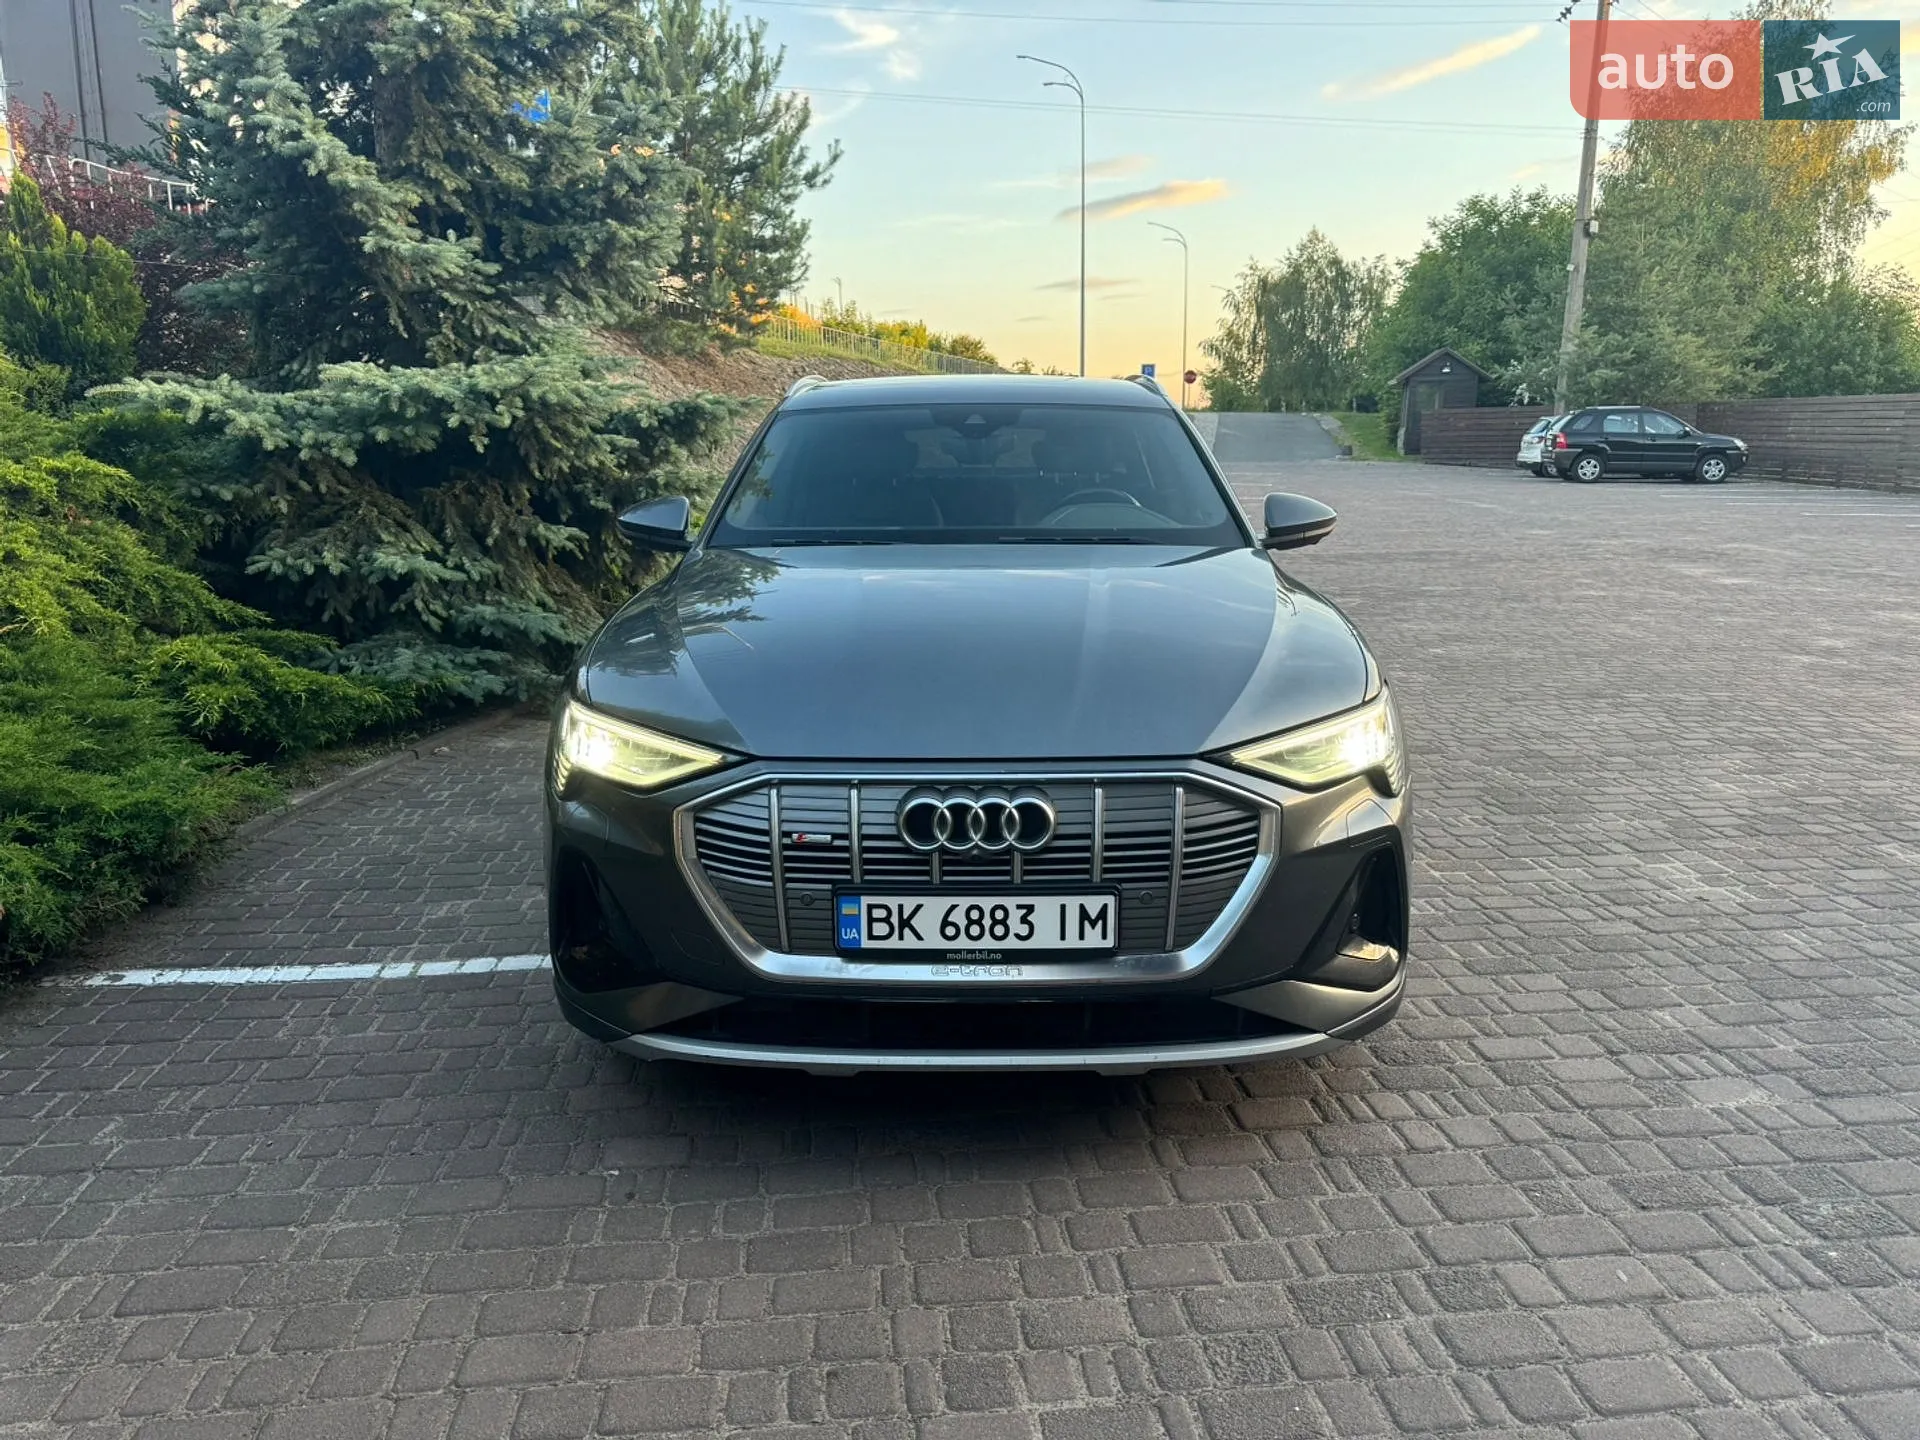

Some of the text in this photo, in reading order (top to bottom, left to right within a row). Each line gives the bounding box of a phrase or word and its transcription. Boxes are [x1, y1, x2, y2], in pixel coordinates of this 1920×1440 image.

[866, 902, 1109, 941] BK 6883 IM
[841, 928, 859, 939] UA
[946, 949, 1002, 960] mollerbil.no
[931, 964, 1024, 977] e-tron
